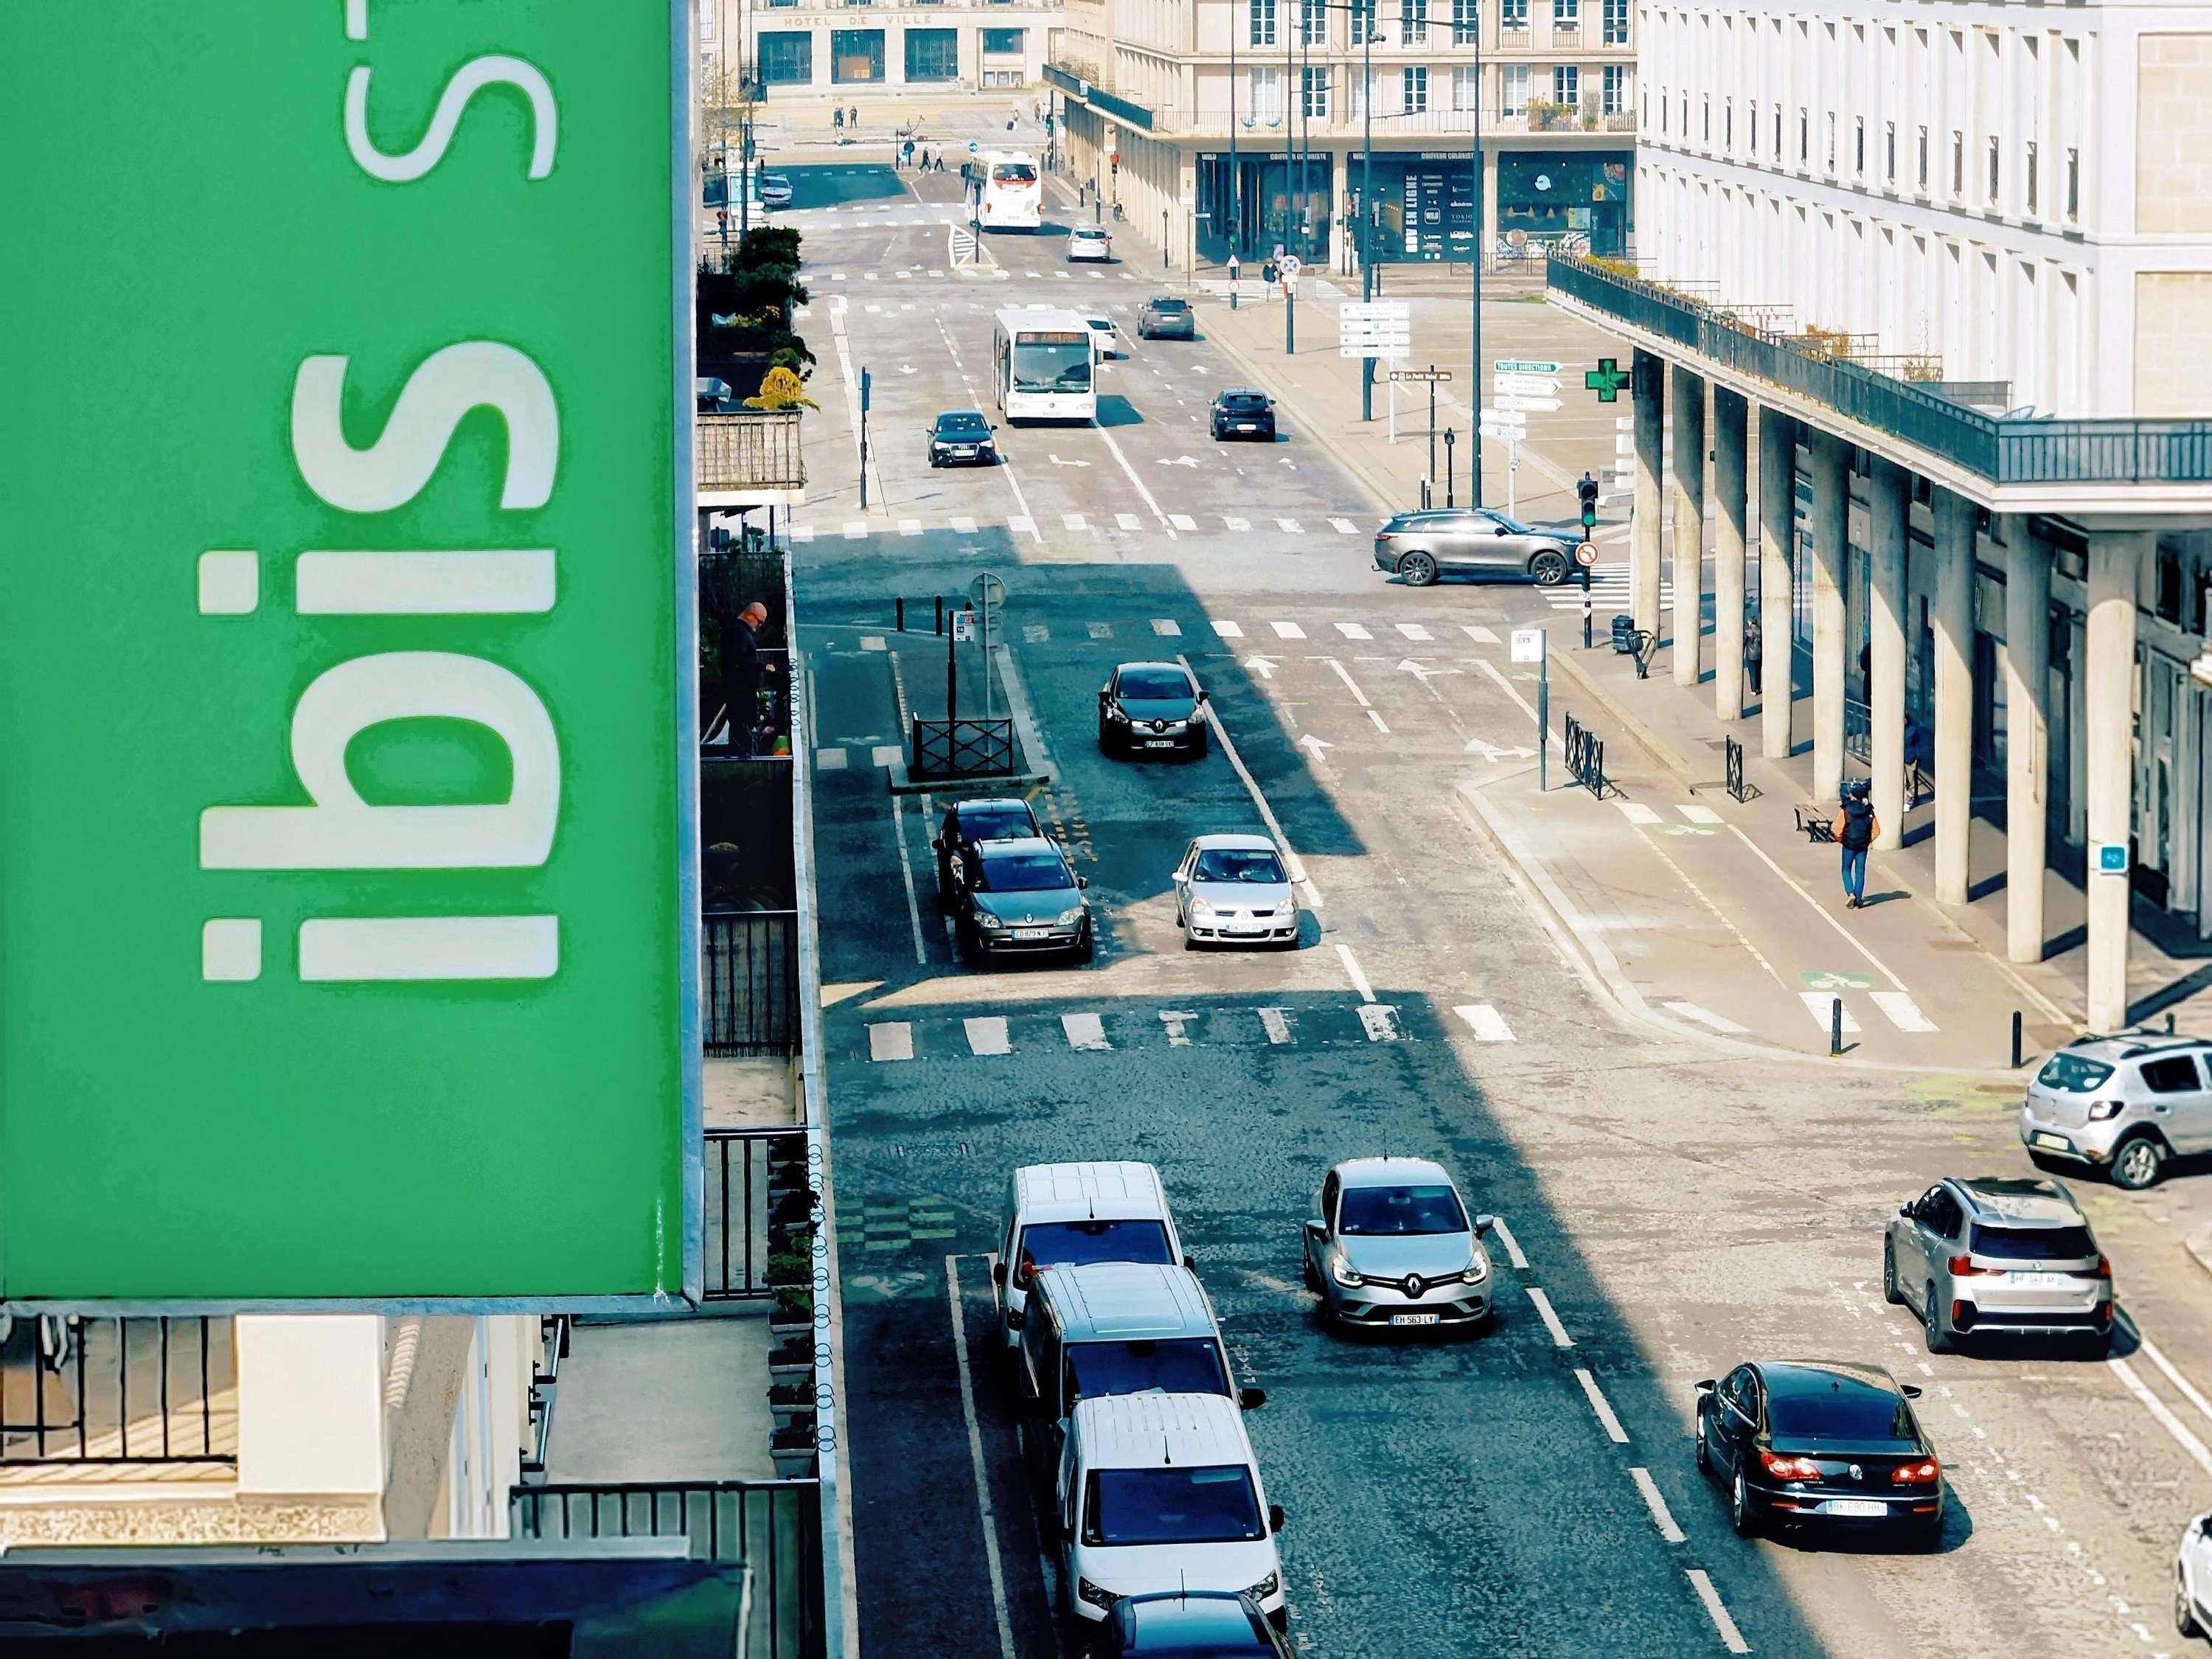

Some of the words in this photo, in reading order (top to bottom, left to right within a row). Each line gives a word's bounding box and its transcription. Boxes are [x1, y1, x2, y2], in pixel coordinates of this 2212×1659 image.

[784, 17, 832, 27] HOTEL
[849, 16, 868, 25] DE
[885, 15, 933, 24] VILLE
[344, 0, 559, 183] s
[1405, 175, 1417, 208] LIGNE
[1405, 211, 1417, 225] EN
[198, 340, 562, 983] ibis
